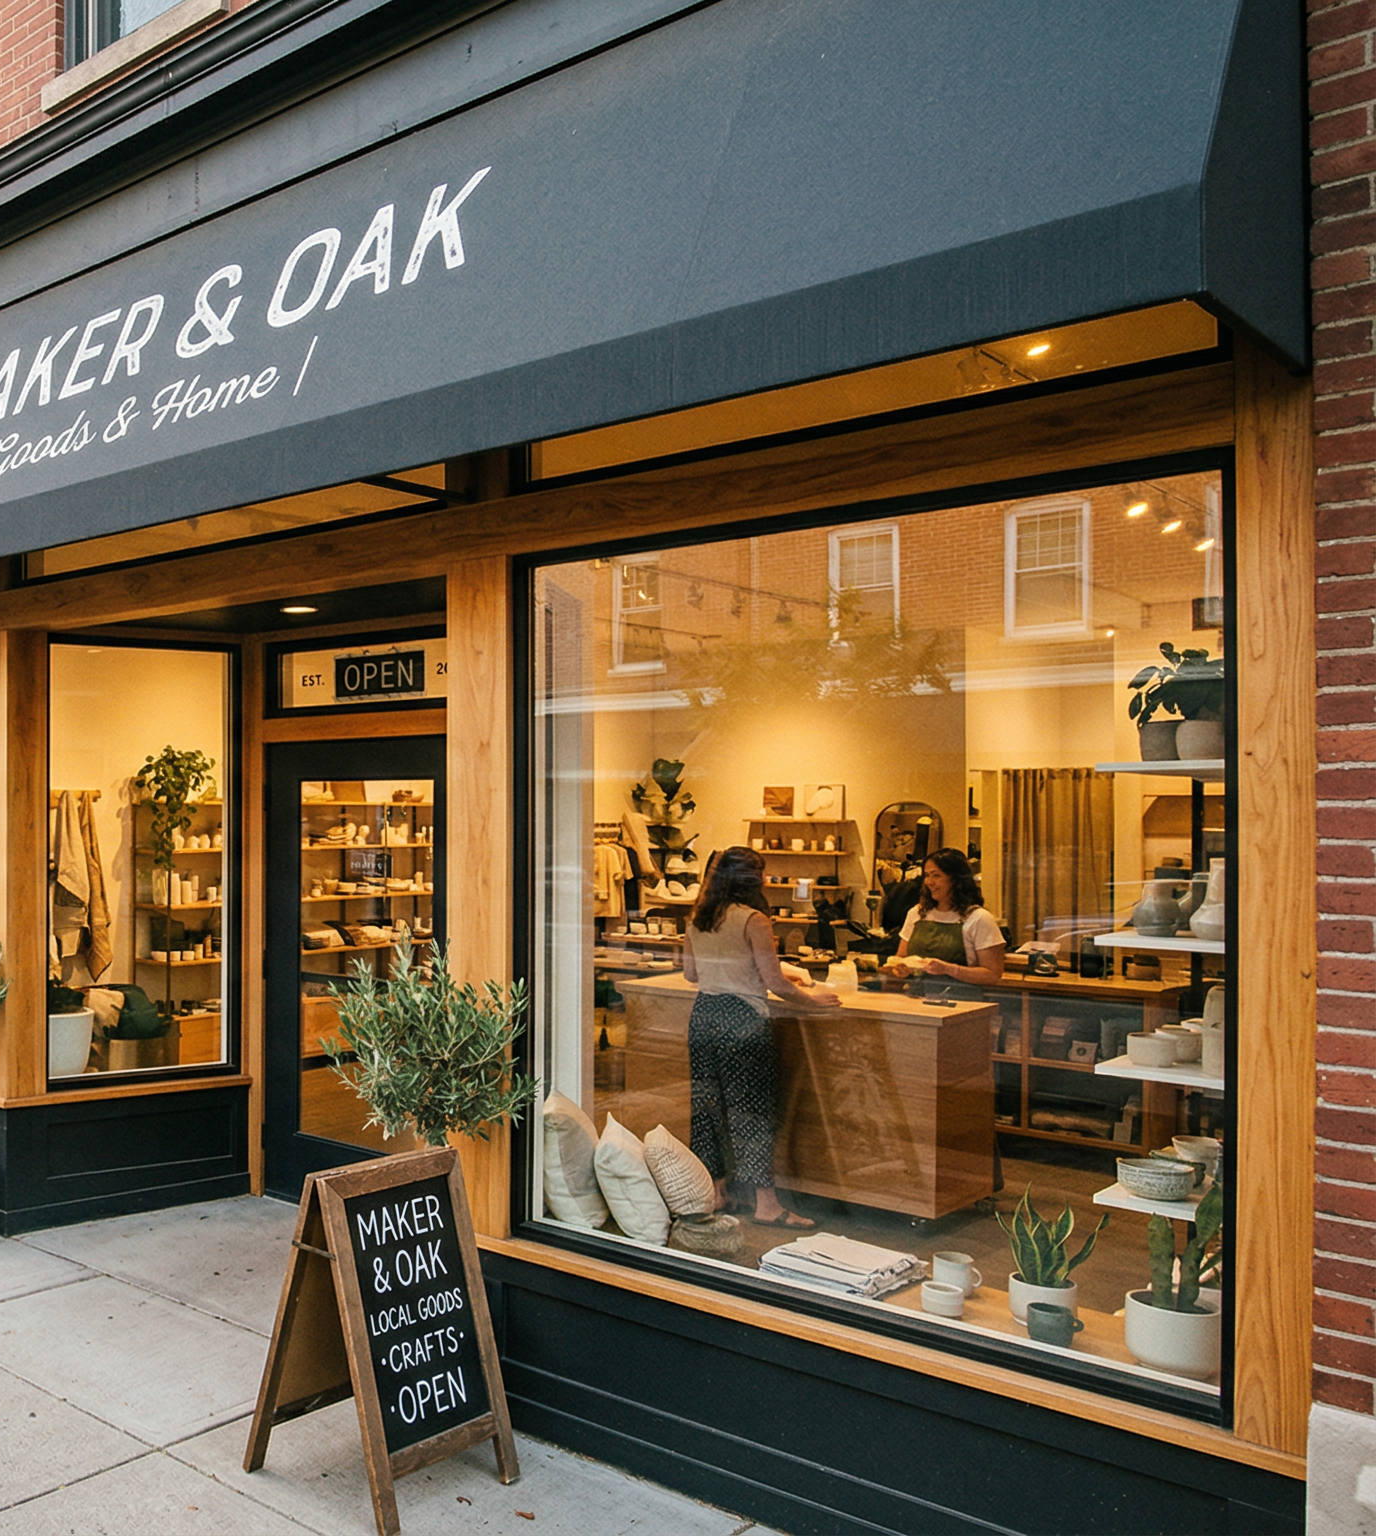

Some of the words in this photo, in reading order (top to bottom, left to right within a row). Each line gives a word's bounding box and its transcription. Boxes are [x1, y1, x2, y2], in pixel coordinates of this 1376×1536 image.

[175, 263, 243, 359] &
[266, 165, 492, 328] OAK
[101, 395, 140, 440] &
[150, 365, 281, 431] Home
[301, 673, 326, 687] EST.
[344, 658, 414, 692] OPEN
[356, 1194, 445, 1252] MAKER
[372, 1256, 392, 1294] &
[395, 1238, 449, 1287] OAK
[370, 1304, 417, 1337] LOCAL
[417, 1287, 464, 1321] GOODS
